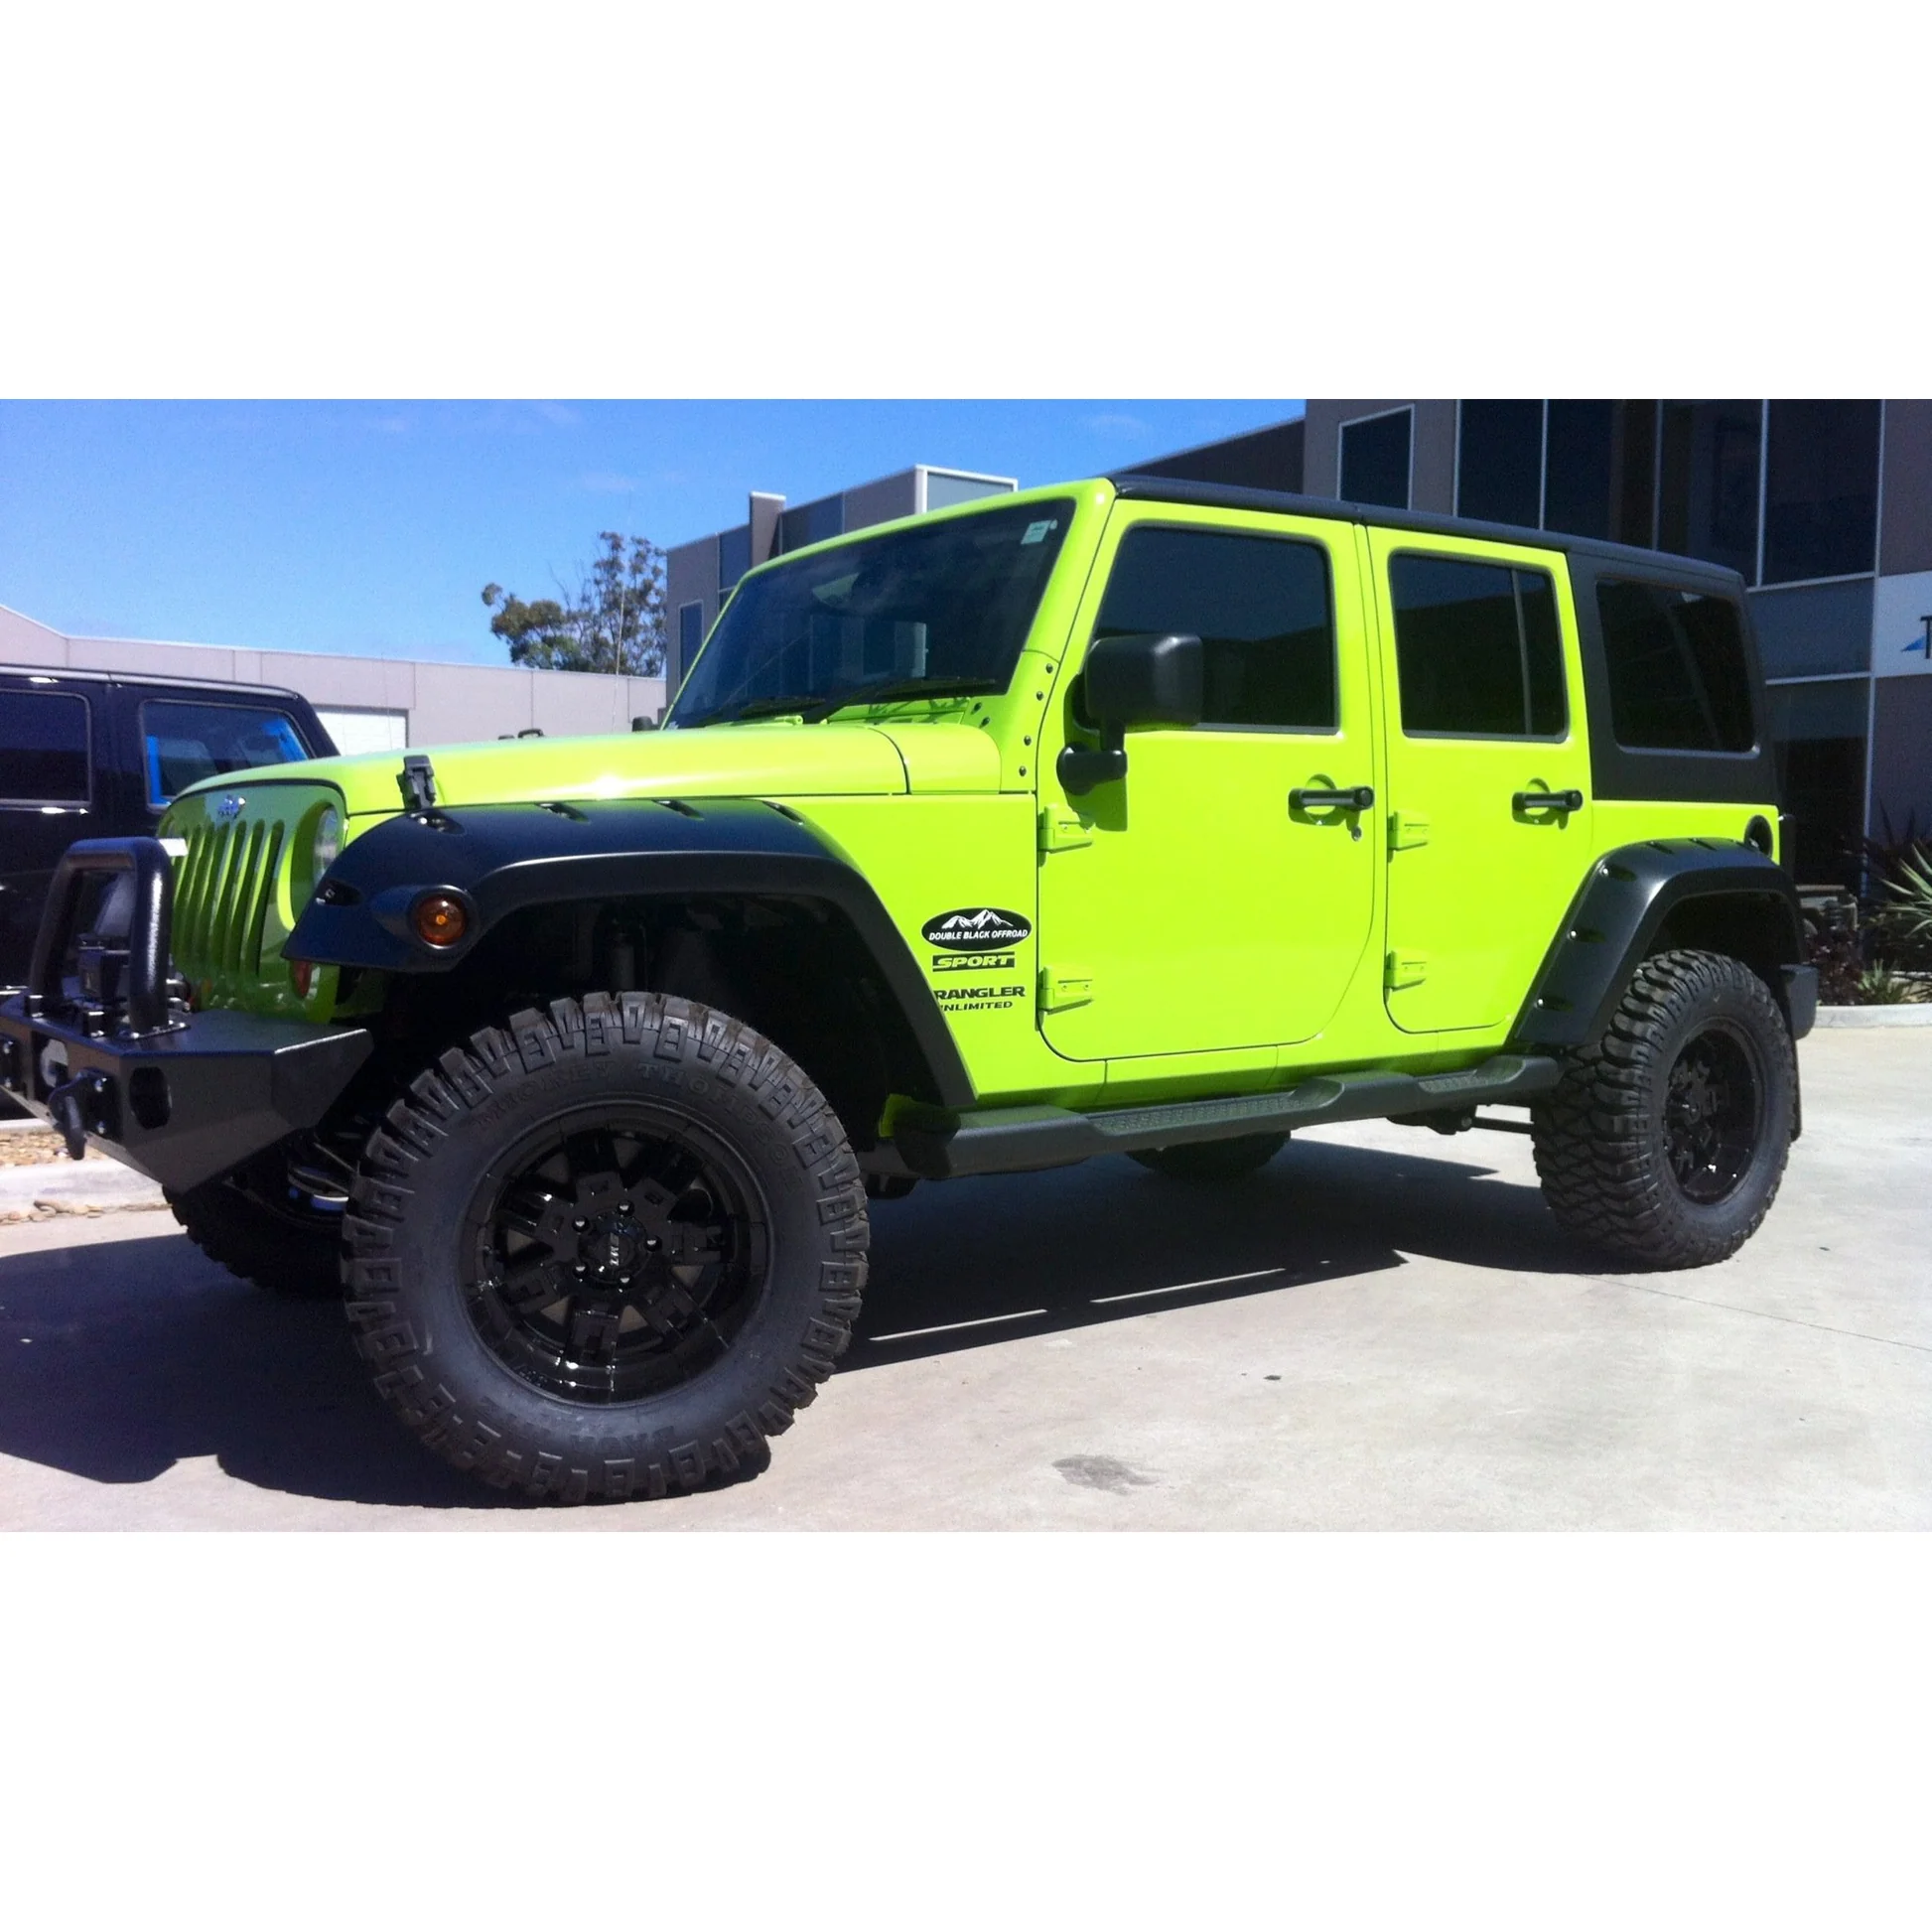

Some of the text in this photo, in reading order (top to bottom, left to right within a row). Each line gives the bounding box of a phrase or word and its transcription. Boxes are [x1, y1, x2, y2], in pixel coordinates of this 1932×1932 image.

[929, 929, 1028, 941] DOUBLE BLACK OFFROAD
[935, 954, 1014, 968] SPORT
[933, 986, 1025, 1000] RANGLER
[940, 1001, 1013, 1012] NLIMITED
